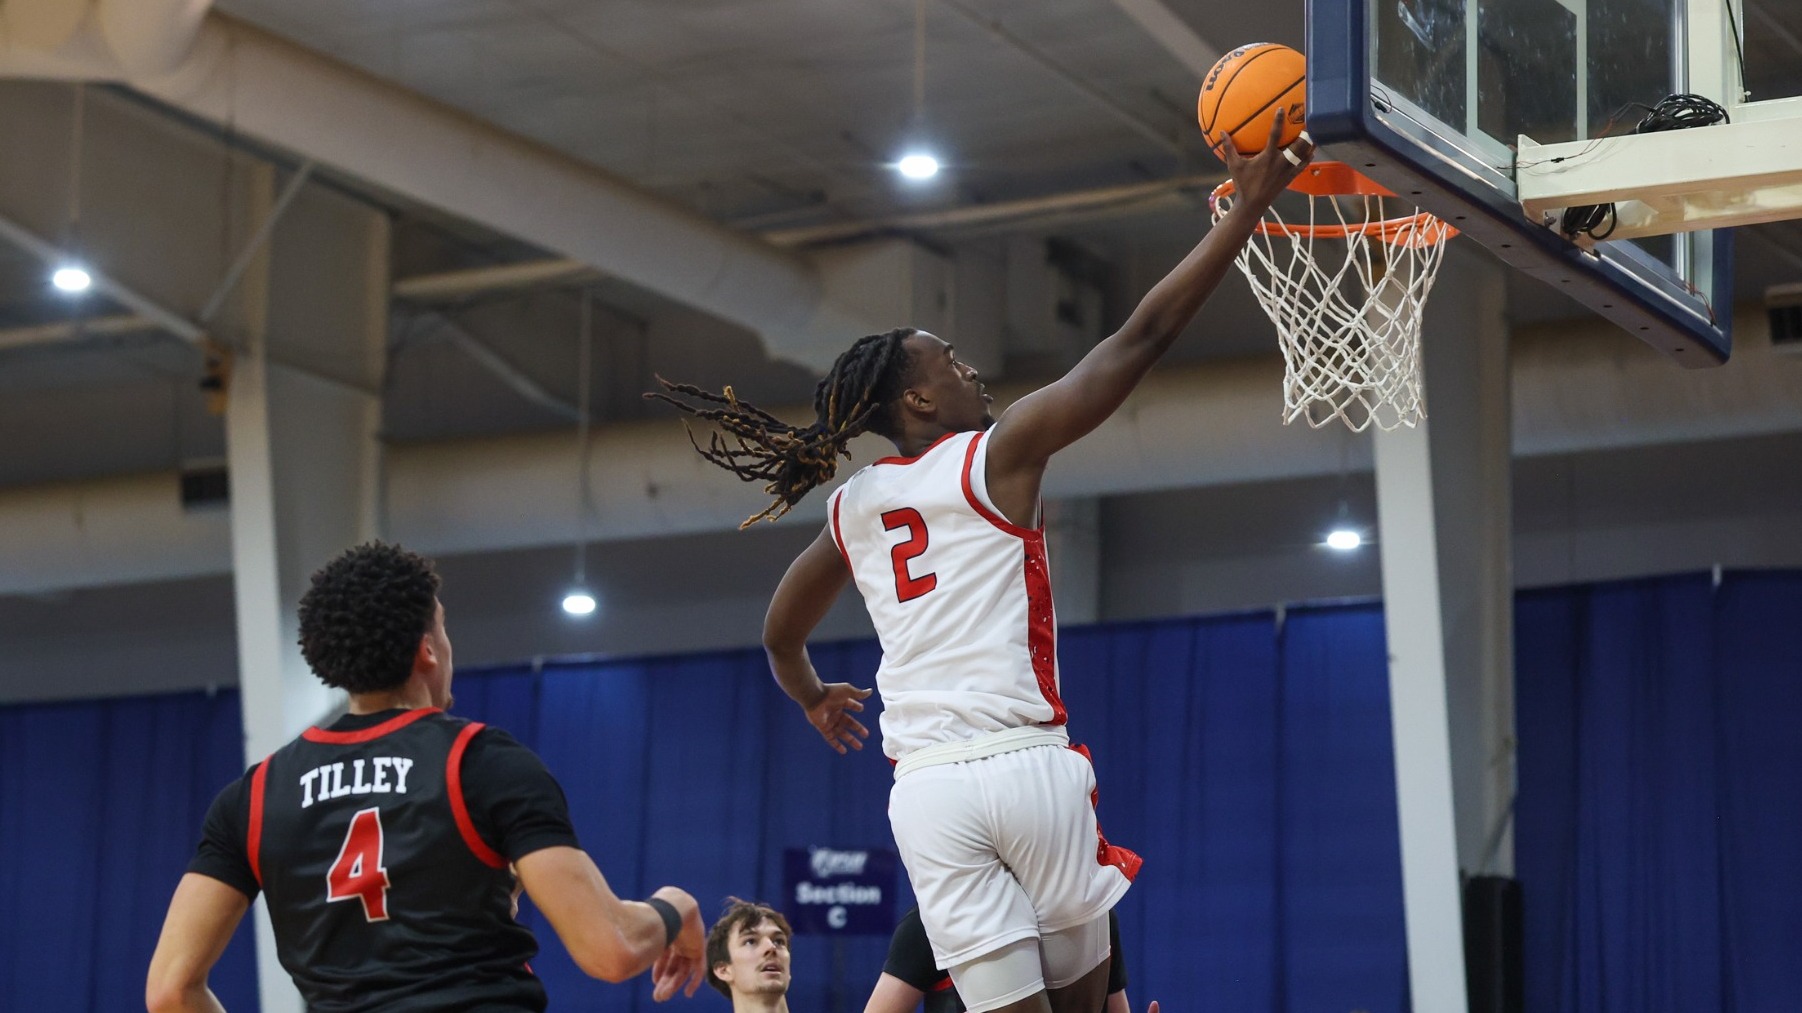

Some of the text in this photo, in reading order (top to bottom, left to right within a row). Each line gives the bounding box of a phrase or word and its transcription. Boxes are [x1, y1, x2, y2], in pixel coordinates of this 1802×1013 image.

[881, 507, 937, 603] 2
[300, 757, 413, 808] TILLEY
[326, 806, 391, 923] 4
[797, 881, 881, 904] Section
[827, 906, 847, 929] C
